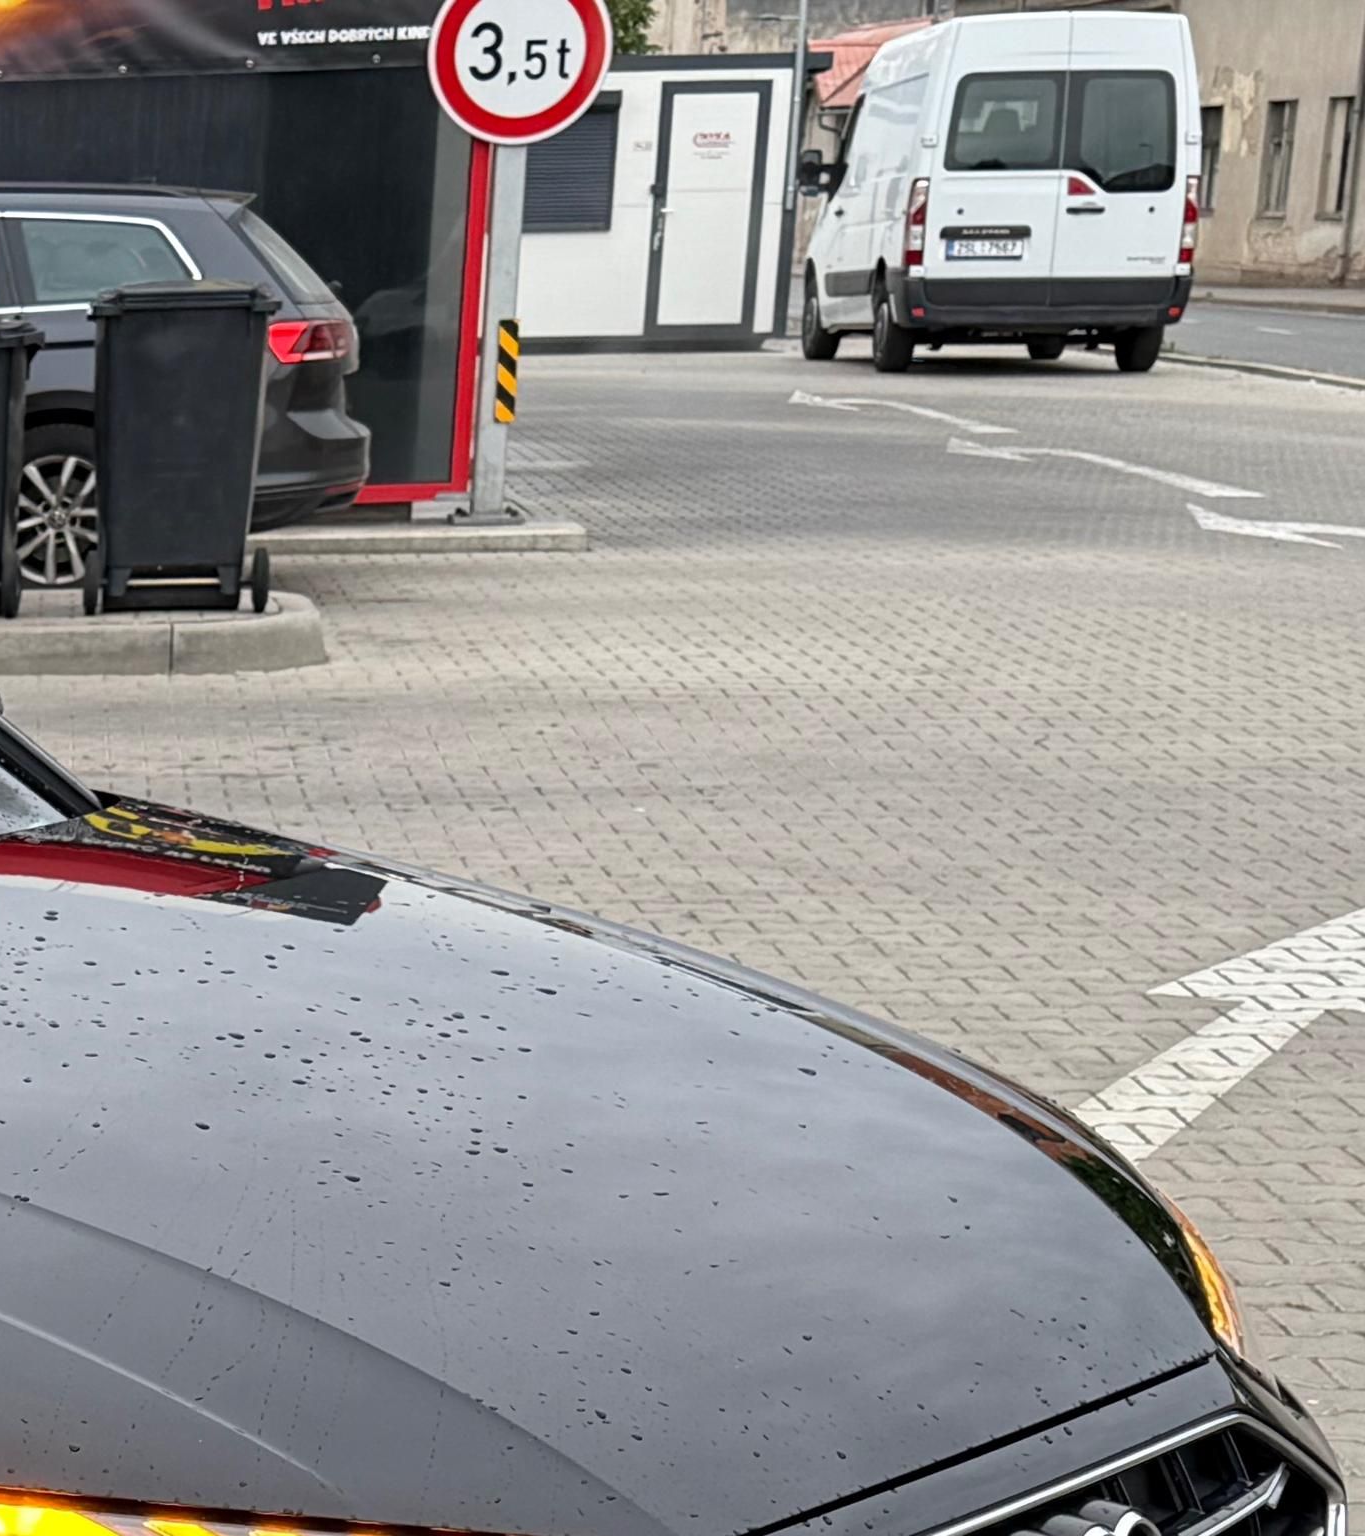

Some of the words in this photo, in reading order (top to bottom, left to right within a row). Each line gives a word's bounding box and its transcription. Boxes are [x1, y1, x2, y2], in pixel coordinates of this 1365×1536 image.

[257, 32, 277, 46] VE
[280, 28, 326, 45] VŠECH
[327, 26, 395, 43] DOBRÝCH
[396, 25, 433, 41] KINE
